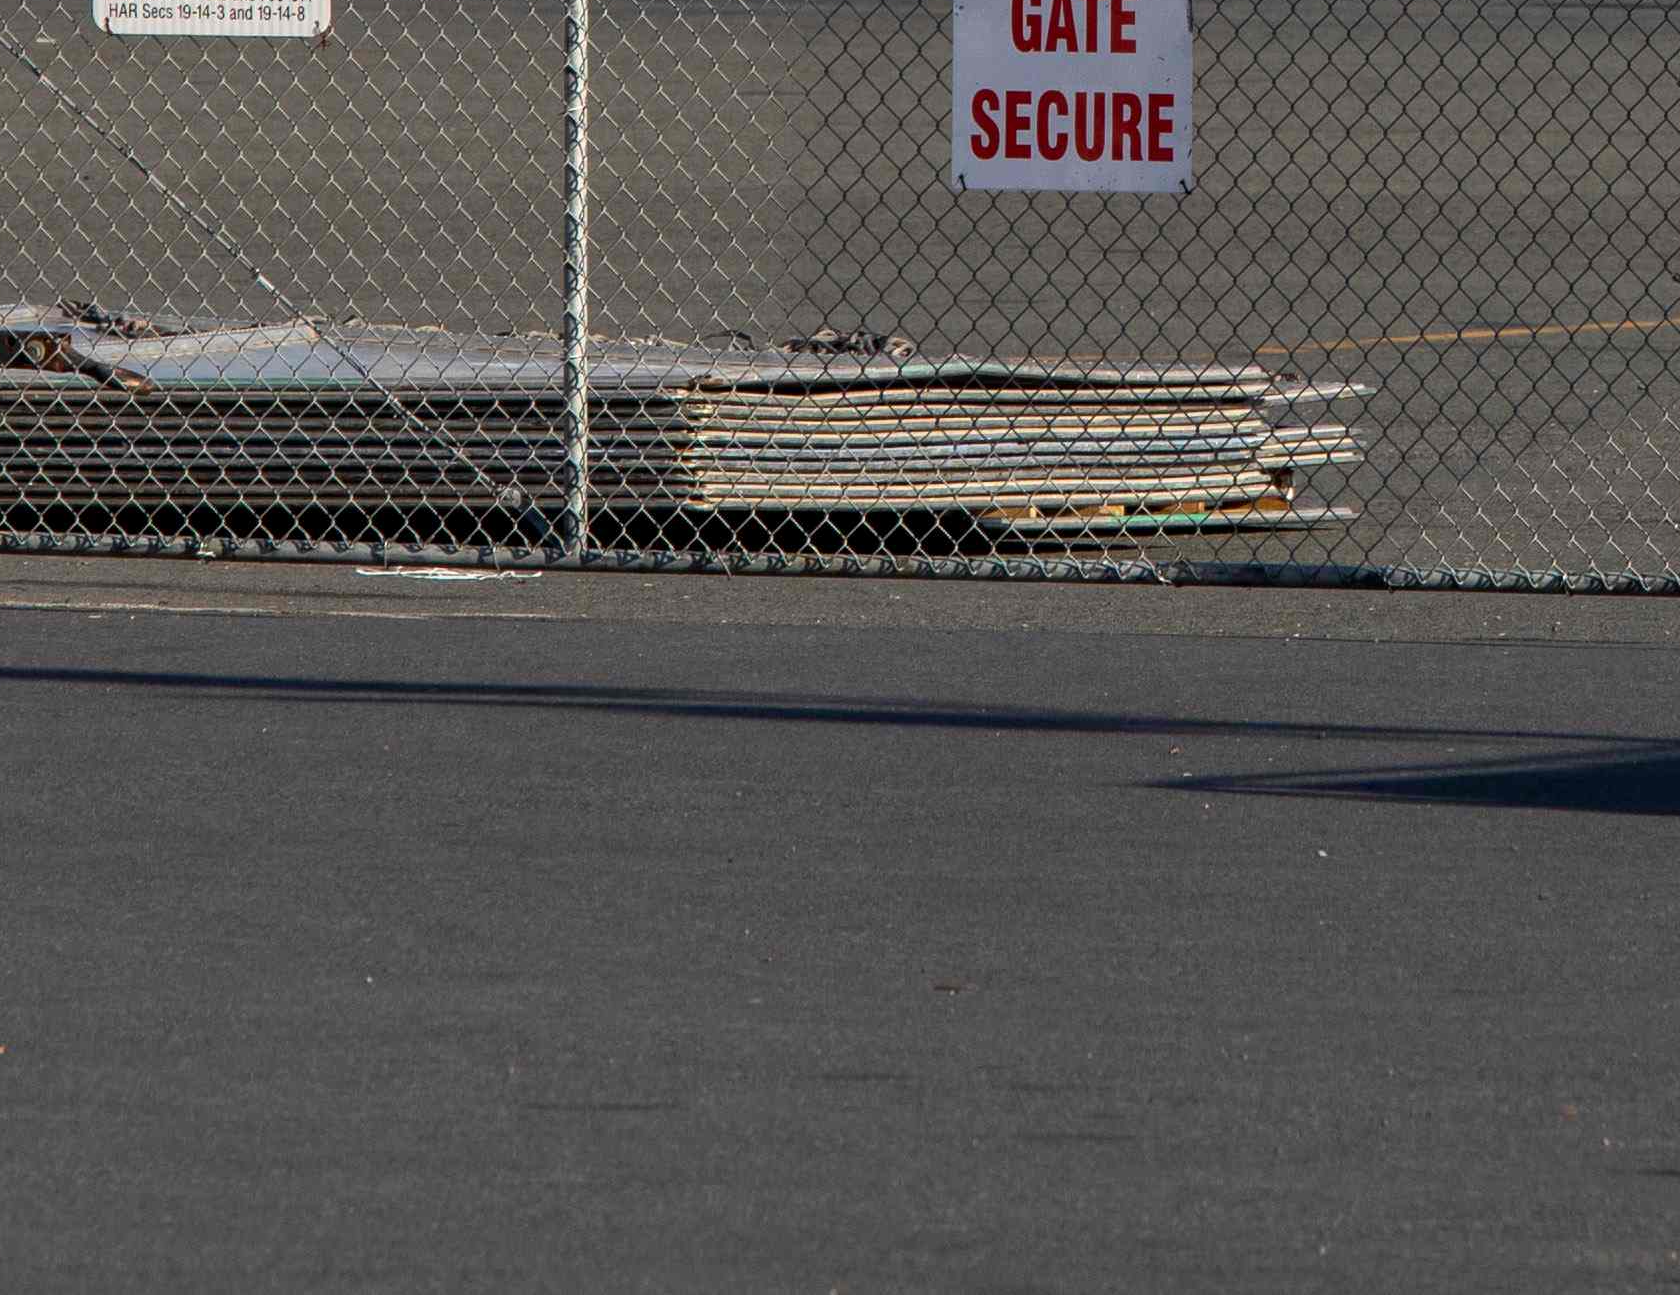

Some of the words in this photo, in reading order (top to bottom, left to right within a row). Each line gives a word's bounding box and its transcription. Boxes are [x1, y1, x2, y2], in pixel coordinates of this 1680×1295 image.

[108, 3, 139, 19] HAR
[142, 3, 173, 20] Secs
[176, 4, 226, 20] 19-14-3
[230, 4, 253, 21] and
[257, 5, 305, 21] 19-14-8
[970, 88, 1175, 162] SECURE
